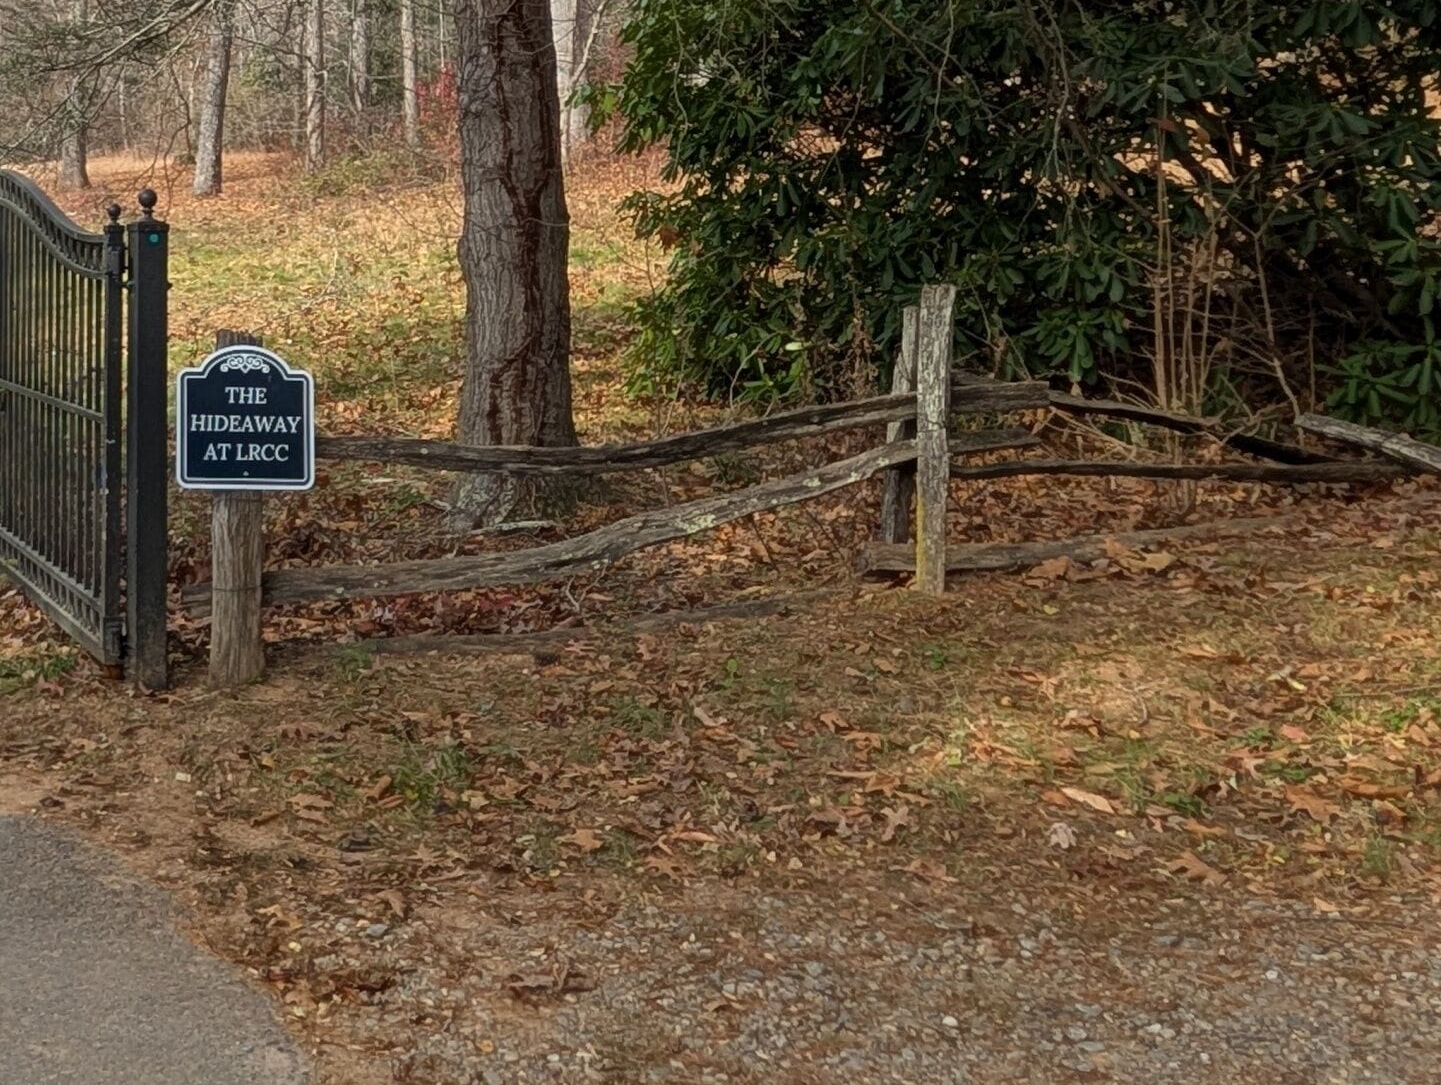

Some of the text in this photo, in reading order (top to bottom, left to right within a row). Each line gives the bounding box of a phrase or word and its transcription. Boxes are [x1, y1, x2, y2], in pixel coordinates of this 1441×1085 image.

[225, 387, 267, 405] THE
[191, 414, 301, 433] HIDEAWAY
[203, 443, 289, 462] AT LRCC
